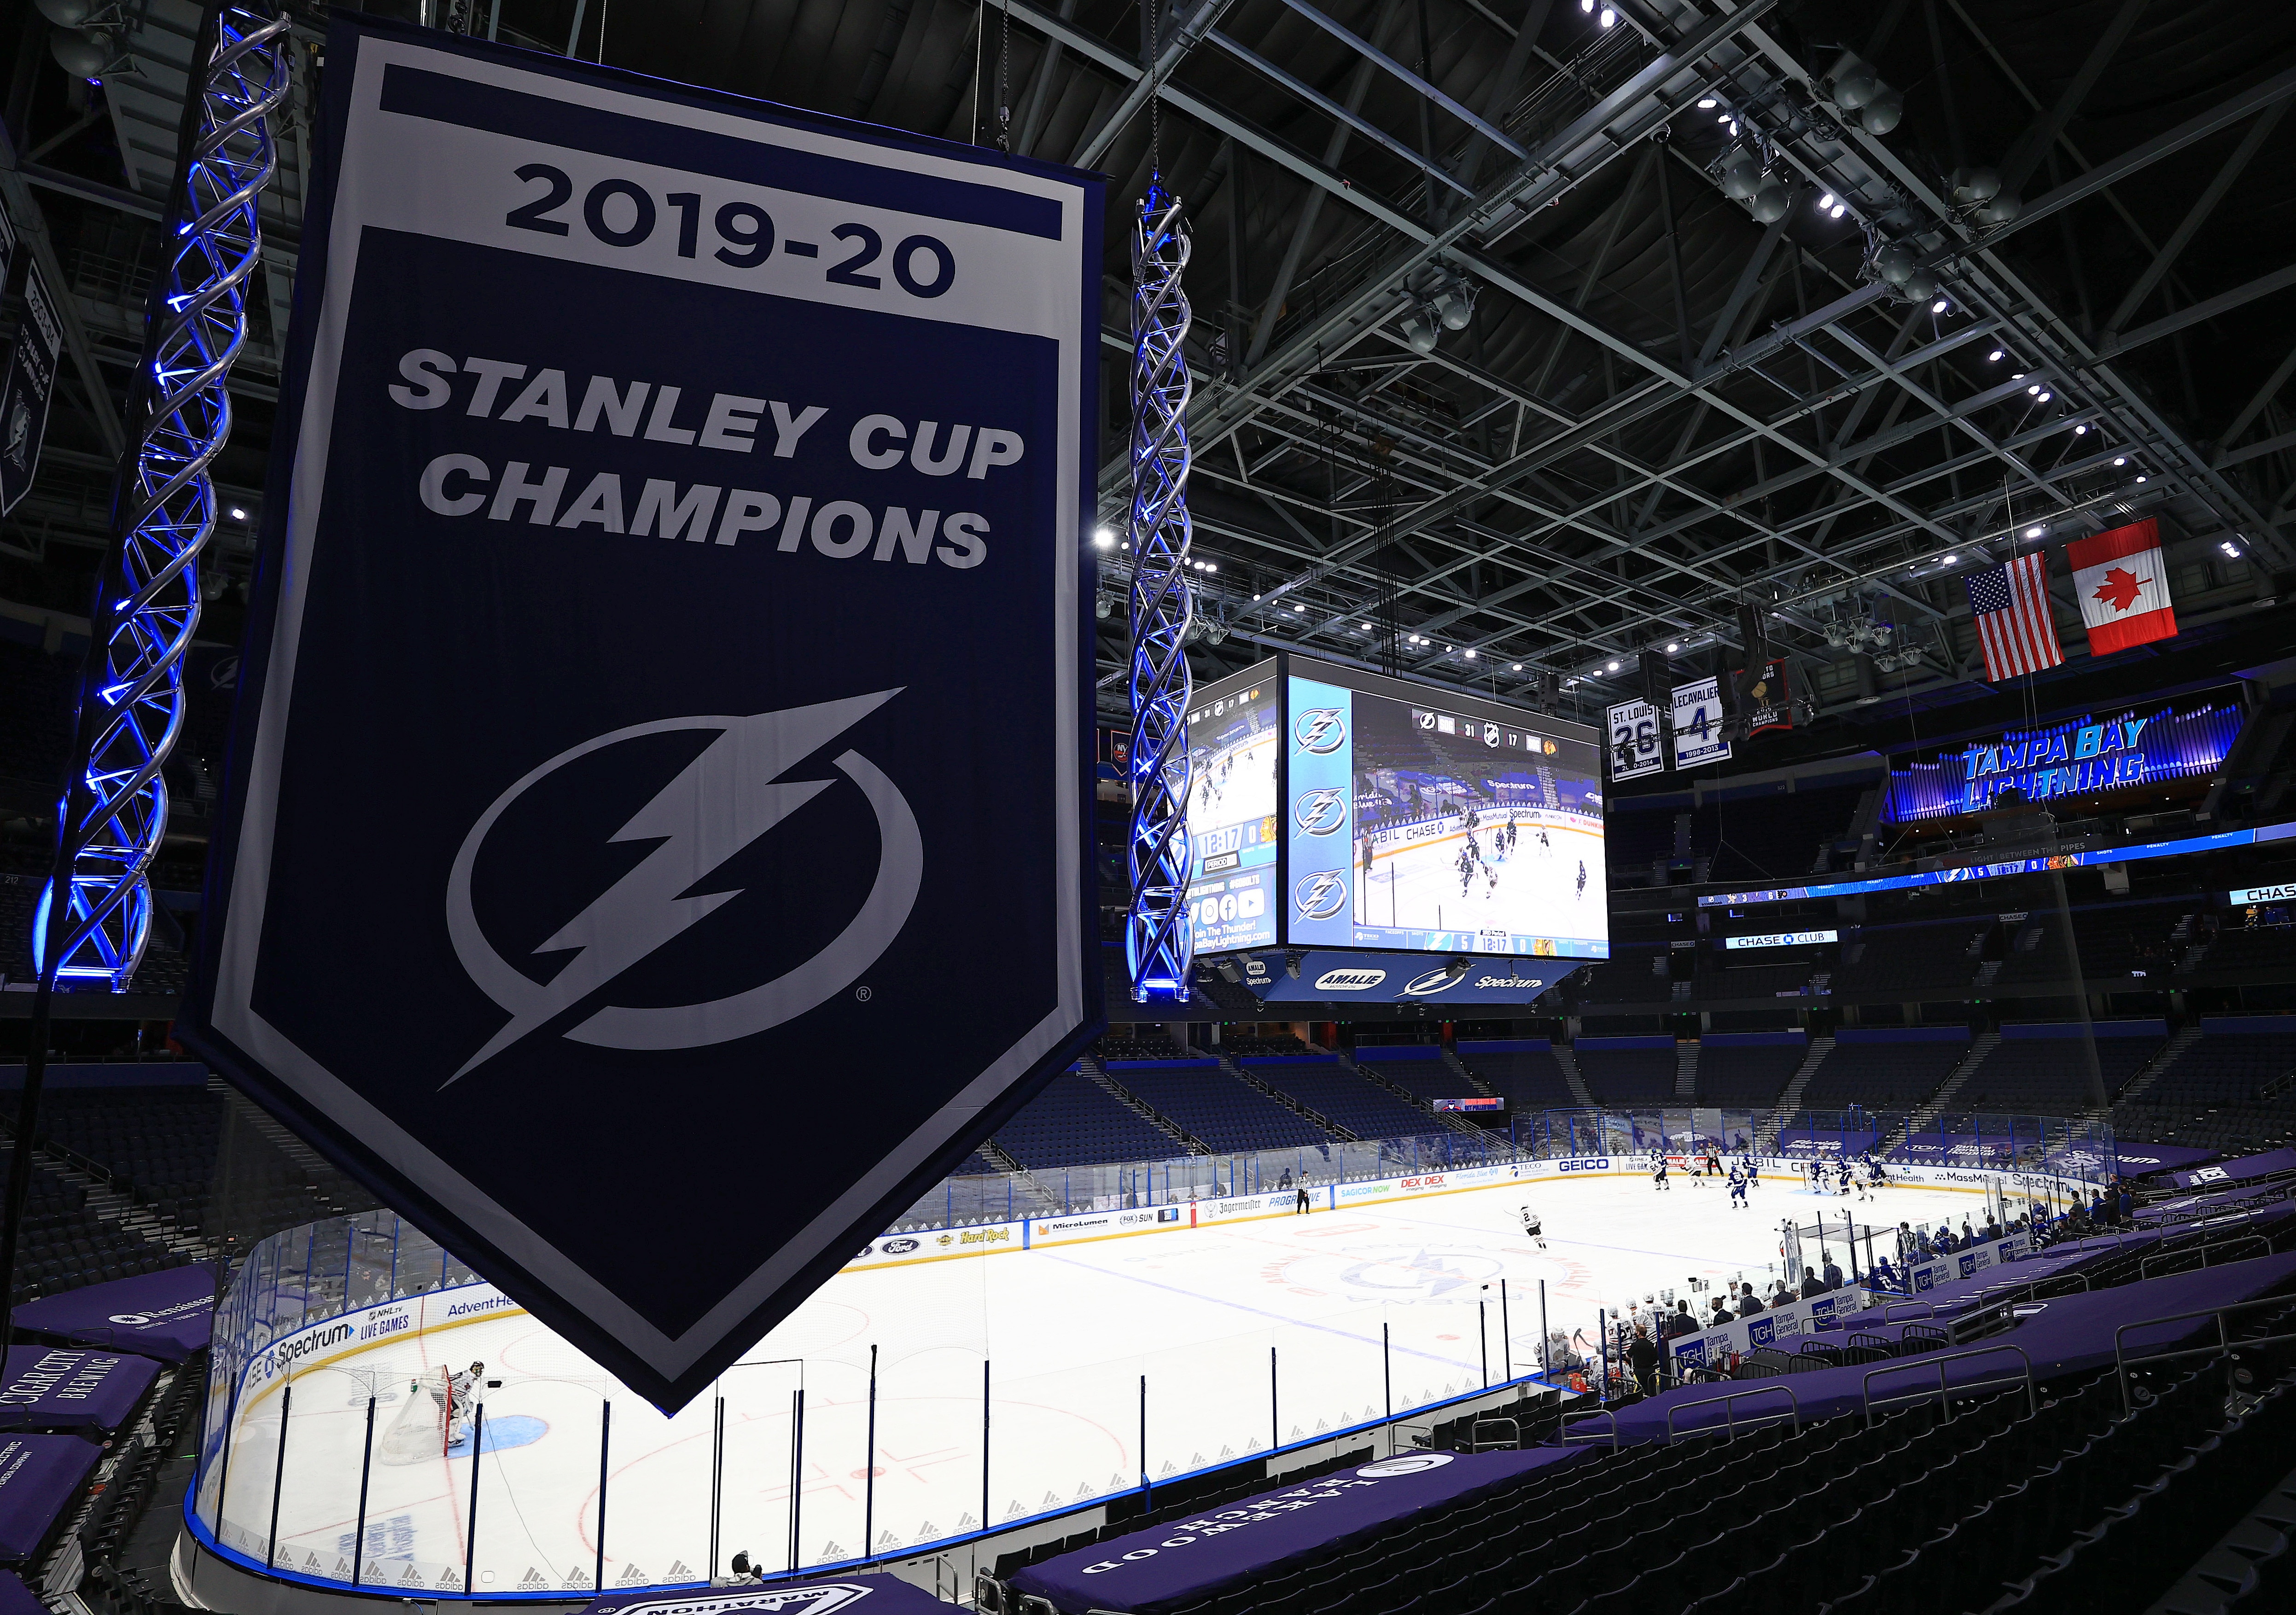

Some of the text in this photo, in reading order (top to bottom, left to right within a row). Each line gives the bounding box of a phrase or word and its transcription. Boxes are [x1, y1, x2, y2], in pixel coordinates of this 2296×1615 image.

[506, 163, 956, 299] 2019-20
[388, 348, 1025, 480] STANLEY CUP
[419, 453, 991, 569] CHAMPIONS
[1673, 686, 1719, 709] LECAVALIER
[1614, 705, 1653, 724] ST. LOUIS
[1689, 705, 1709, 742] 4
[1753, 717, 1778, 727] CHAMPIONS
[1465, 724, 1474, 737] 31
[1509, 734, 1518, 746] 17
[1686, 744, 1719, 758] 1998-2013
[1964, 717, 2149, 780] TAMPA BAY
[1373, 829, 1400, 844] ABIL
[1407, 824, 1435, 840] CHASE
[1509, 809, 1540, 820] Spectrum
[1205, 825, 1256, 855] 12:17 0
[2061, 842, 2085, 852] PIPES
[1207, 858, 1227, 869] PERIOD
[1195, 920, 1256, 938] oin The Thunder!
[1462, 935, 1468, 950] 5
[1483, 938, 1506, 952] 12:17
[1738, 934, 1824, 947] CHASE CLUB
[1247, 976, 1270, 986] Spectrum
[1323, 973, 1381, 986] AMALIE
[1475, 976, 1543, 989] Spectrum
[1560, 1159, 1608, 1171] GEICO
[1732, 1157, 1781, 1168] JBIL
[1401, 1175, 1444, 1188] DEX DEX
[1888, 1174, 1924, 1182] ntHealth
[1139, 1214, 1153, 1222] SUN
[1523, 1213, 1530, 1222] 2
[1053, 1220, 1107, 1230] MicroLumen
[961, 1227, 1008, 1244] Hard Rock
[888, 1241, 912, 1253] Ford
[1975, 1251, 1987, 1260] Tampa
[1933, 1263, 1947, 1274] Tampa
[1963, 1261, 1974, 1272] TGH
[1918, 1273, 1932, 1287] TGH
[1934, 1271, 1949, 1282] General
[448, 1295, 513, 1317] AdventHe
[1835, 1294, 1853, 1305] Tampa
[136, 1295, 215, 1319] Renaissan
[1837, 1304, 1857, 1315] General
[1774, 1312, 1795, 1324] Tampa
[361, 1315, 408, 1340] LIVE GAMES
[1754, 1324, 1772, 1342] TGH
[1776, 1319, 1798, 1335] General
[277, 1324, 348, 1369] Spectrum
[1706, 1333, 1729, 1347] Tampa
[1681, 1348, 1703, 1366] TGH
[0, 1350, 86, 1404] CIGAR CITY
[56, 1358, 116, 1400] BREWING
